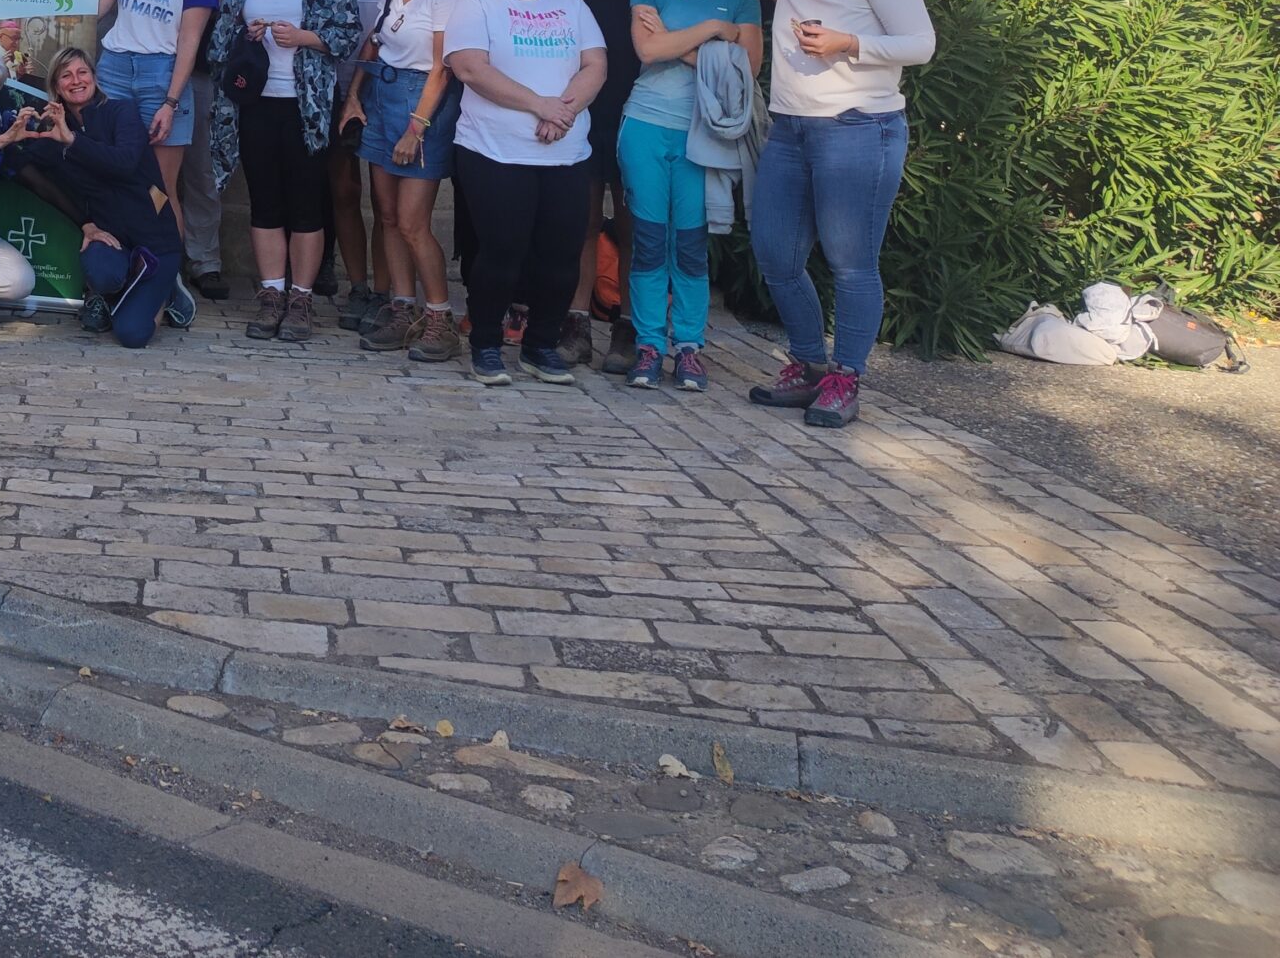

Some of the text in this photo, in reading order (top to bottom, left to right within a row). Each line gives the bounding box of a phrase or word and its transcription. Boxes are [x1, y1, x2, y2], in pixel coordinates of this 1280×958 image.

[130, 0, 174, 24] MAGIC
[507, 7, 567, 20] holidays
[513, 34, 577, 49] holidays
[514, 46, 577, 61] holidays
